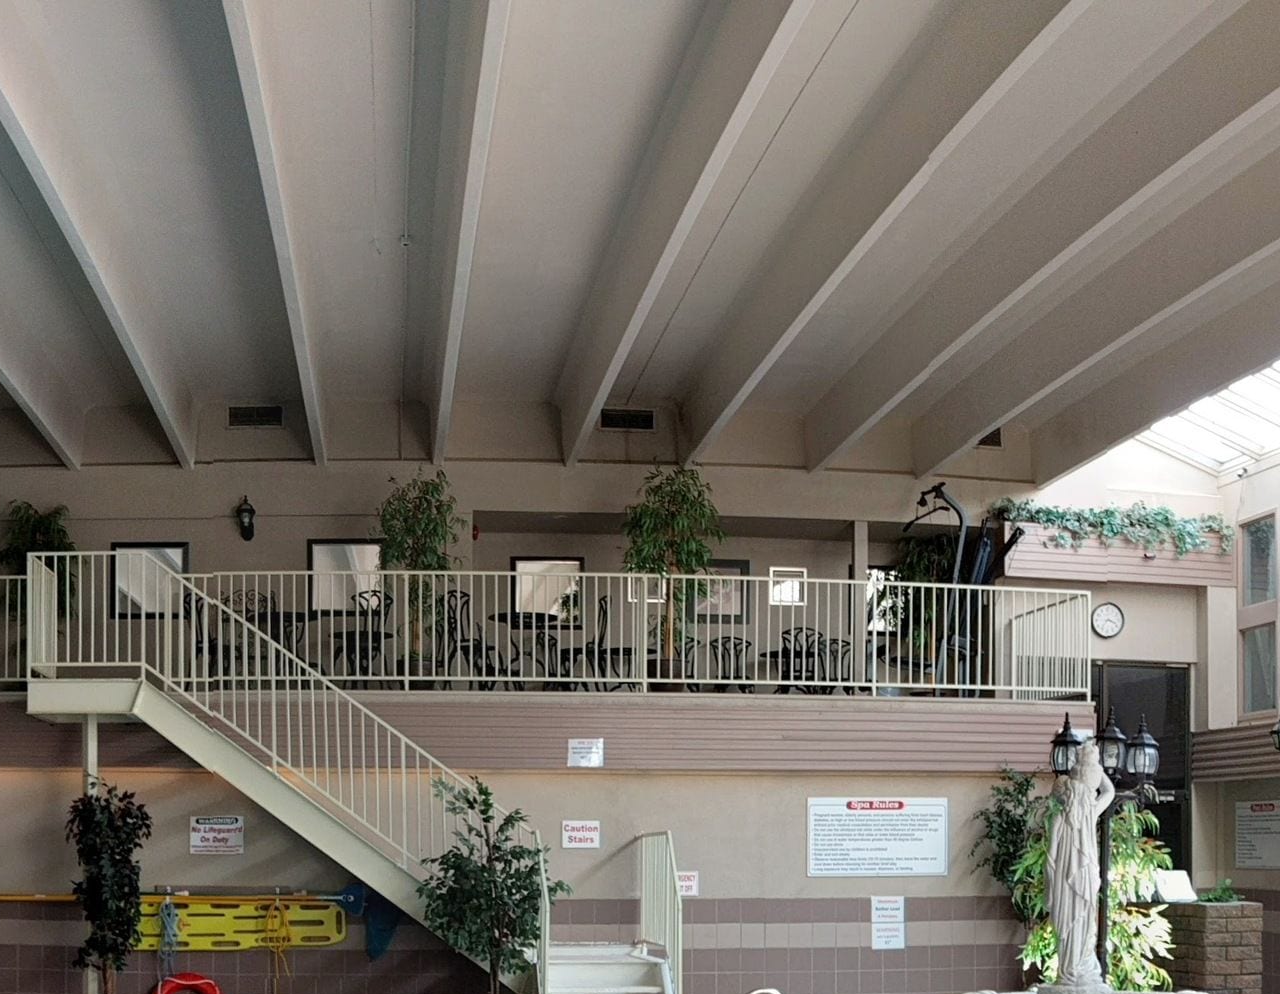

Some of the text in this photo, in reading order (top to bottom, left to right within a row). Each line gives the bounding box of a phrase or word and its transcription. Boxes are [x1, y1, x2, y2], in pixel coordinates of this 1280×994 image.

[850, 801, 899, 810] Spa Rules
[563, 824, 599, 833] Caution
[212, 836, 229, 845] Duty
[567, 835, 595, 844] Stairs
